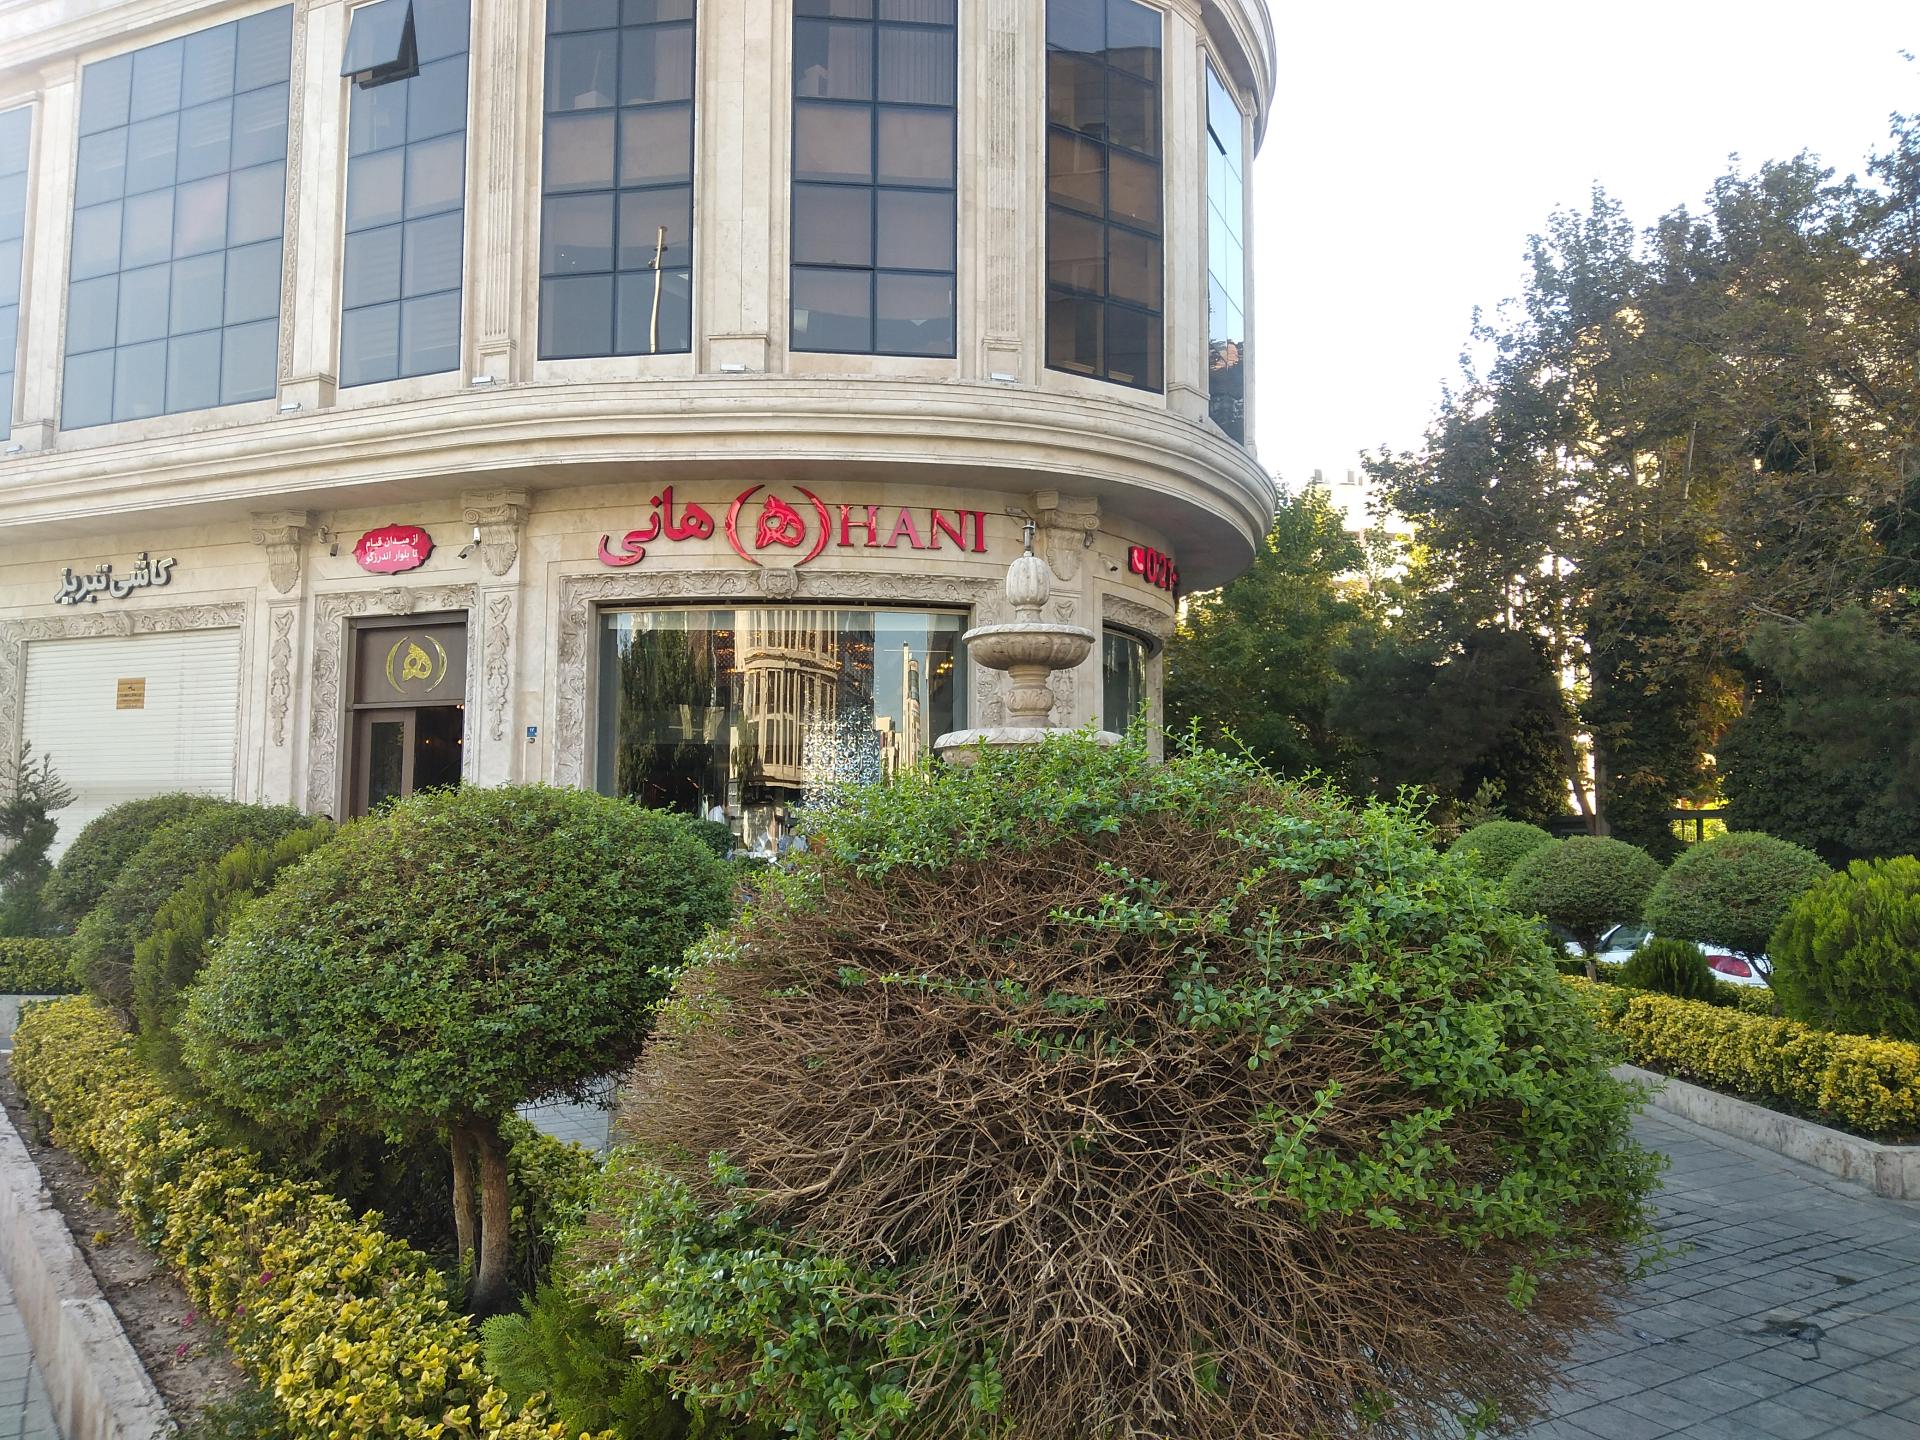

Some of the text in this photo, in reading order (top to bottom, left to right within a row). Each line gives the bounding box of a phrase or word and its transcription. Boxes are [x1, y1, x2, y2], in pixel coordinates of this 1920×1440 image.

[411, 533, 419, 546] از
[598, 485, 715, 567] هانی
[836, 504, 988, 553] HANI
[365, 536, 382, 553] قیام
[365, 548, 418, 565] تا بلوار اندرزگو
[54, 552, 177, 605] کاشی تبریز
